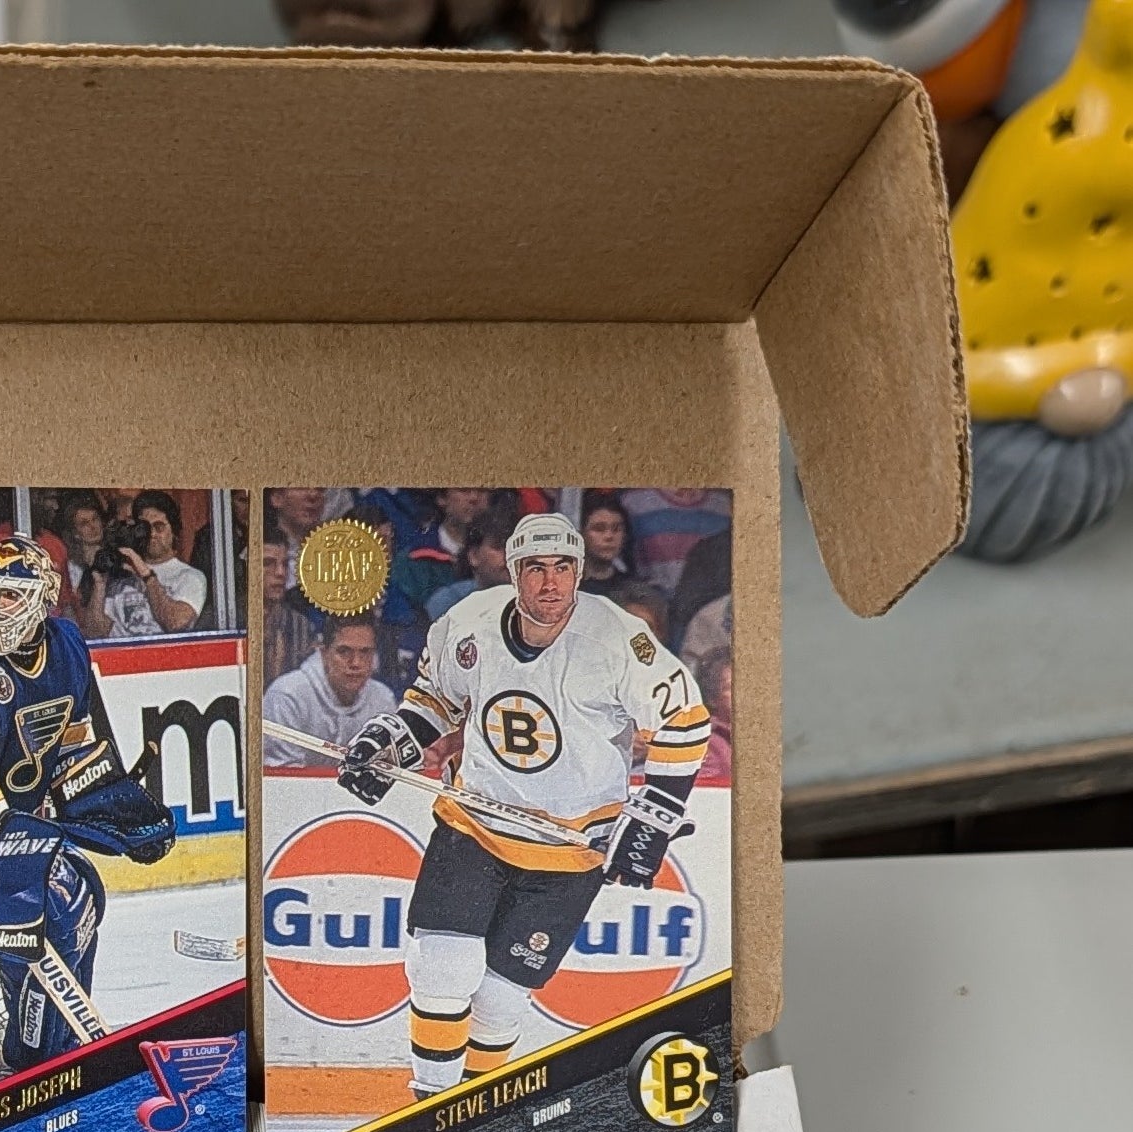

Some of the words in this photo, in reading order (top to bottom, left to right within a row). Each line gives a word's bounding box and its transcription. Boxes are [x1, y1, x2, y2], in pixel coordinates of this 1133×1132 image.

[314, 551, 374, 582] LEAF
[652, 668, 689, 720] 27
[501, 710, 539, 756] B
[61, 759, 113, 801] Heaton
[262, 888, 402, 949] Gul
[574, 904, 695, 957] ulf
[195, 1045, 220, 1056] LOUIS
[17, 1065, 82, 1113] JOSEPH
[435, 1095, 488, 1132] STEVE
[493, 1065, 548, 1109] LEACH
[663, 1051, 702, 1113] B
[532, 1098, 571, 1127] BRUINS
